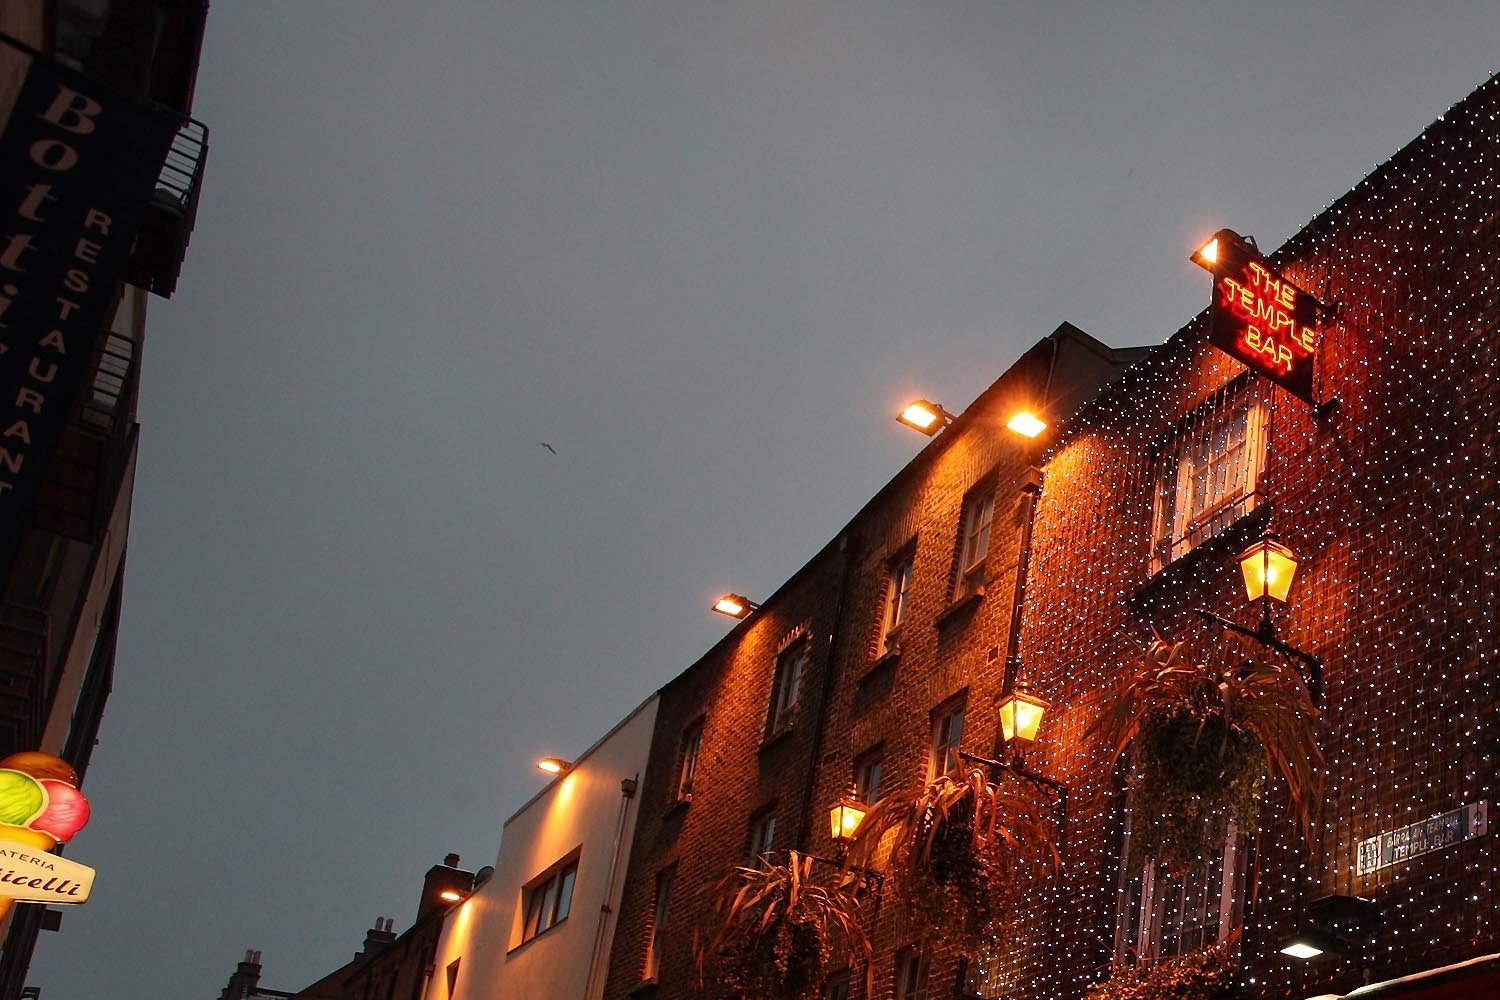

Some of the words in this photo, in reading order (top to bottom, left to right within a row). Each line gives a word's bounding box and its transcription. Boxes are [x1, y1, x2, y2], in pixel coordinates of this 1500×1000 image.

[1250, 261, 1295, 310] THE
[1224, 277, 1315, 352] TEMPLE
[1245, 325, 1293, 371] BAR
[1394, 838, 1429, 858] TEMPLE
[1434, 830, 1455, 844] BAR
[0, 867, 81, 896] icelli
